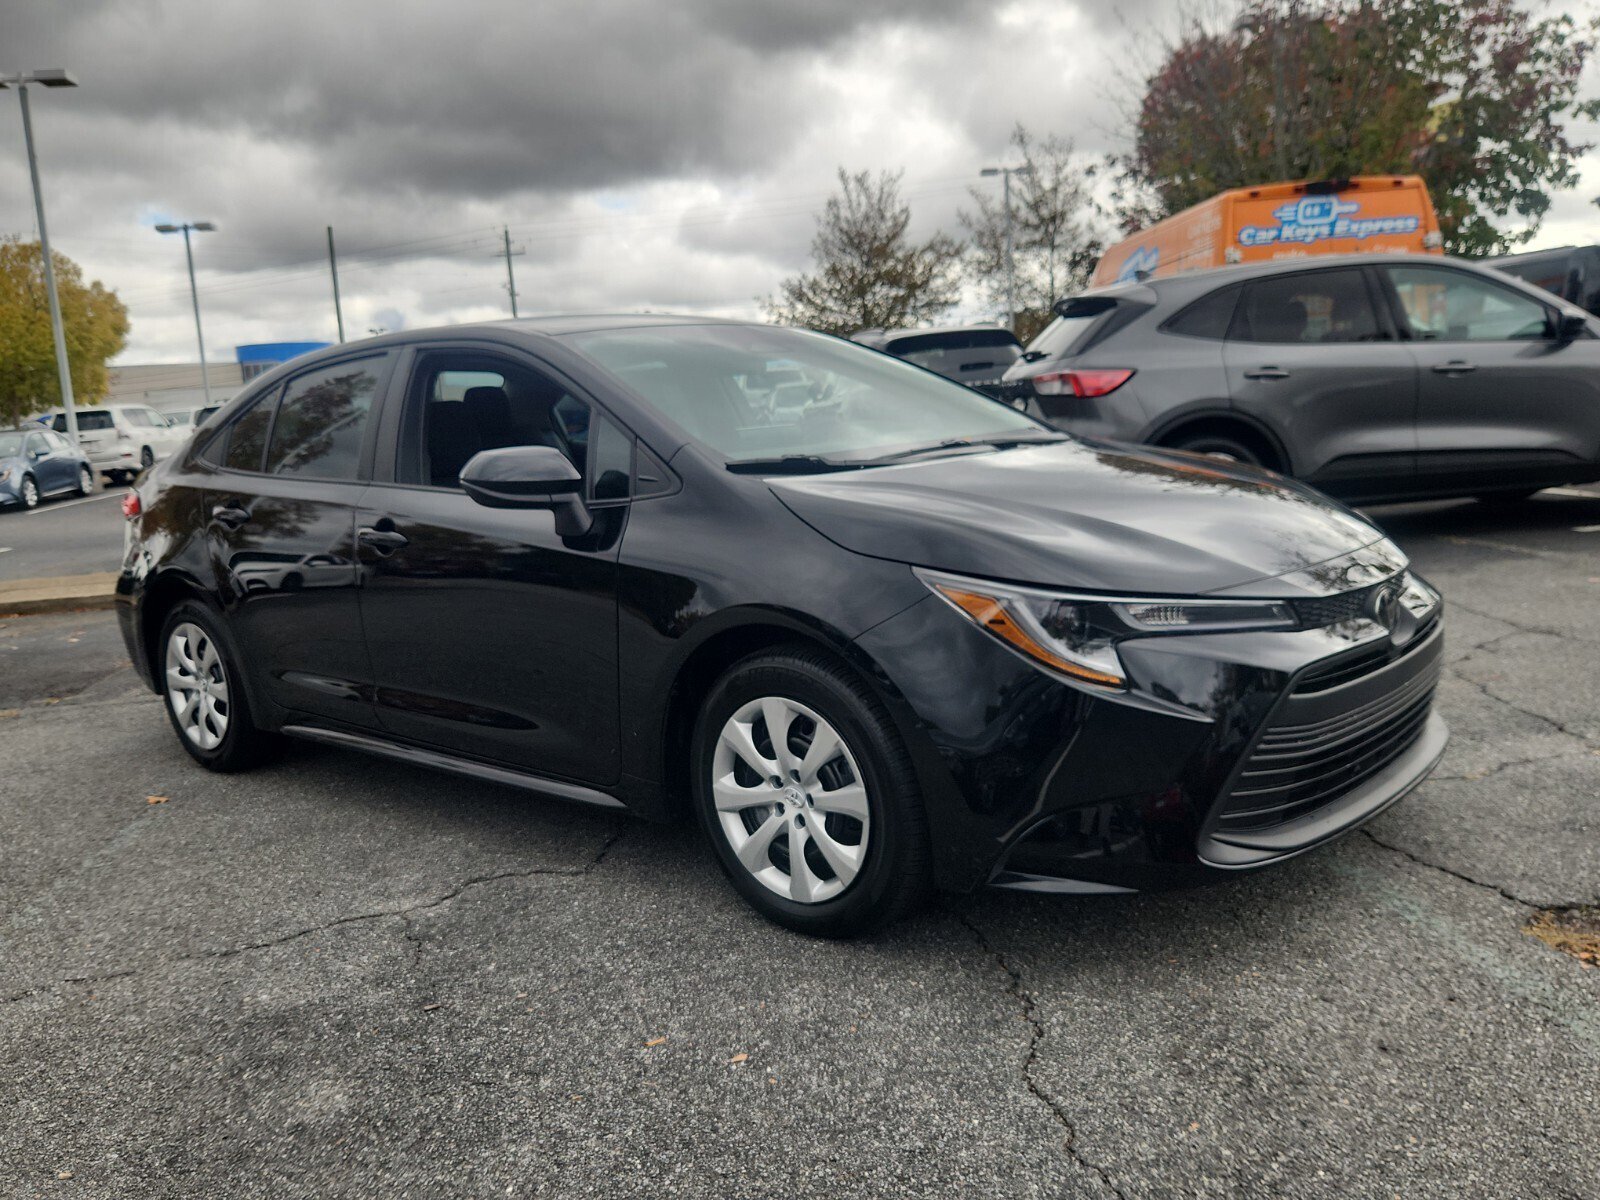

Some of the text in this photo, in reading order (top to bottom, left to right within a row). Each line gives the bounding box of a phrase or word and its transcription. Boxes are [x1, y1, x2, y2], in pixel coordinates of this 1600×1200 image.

[1240, 217, 1417, 245] Car Keys Express
